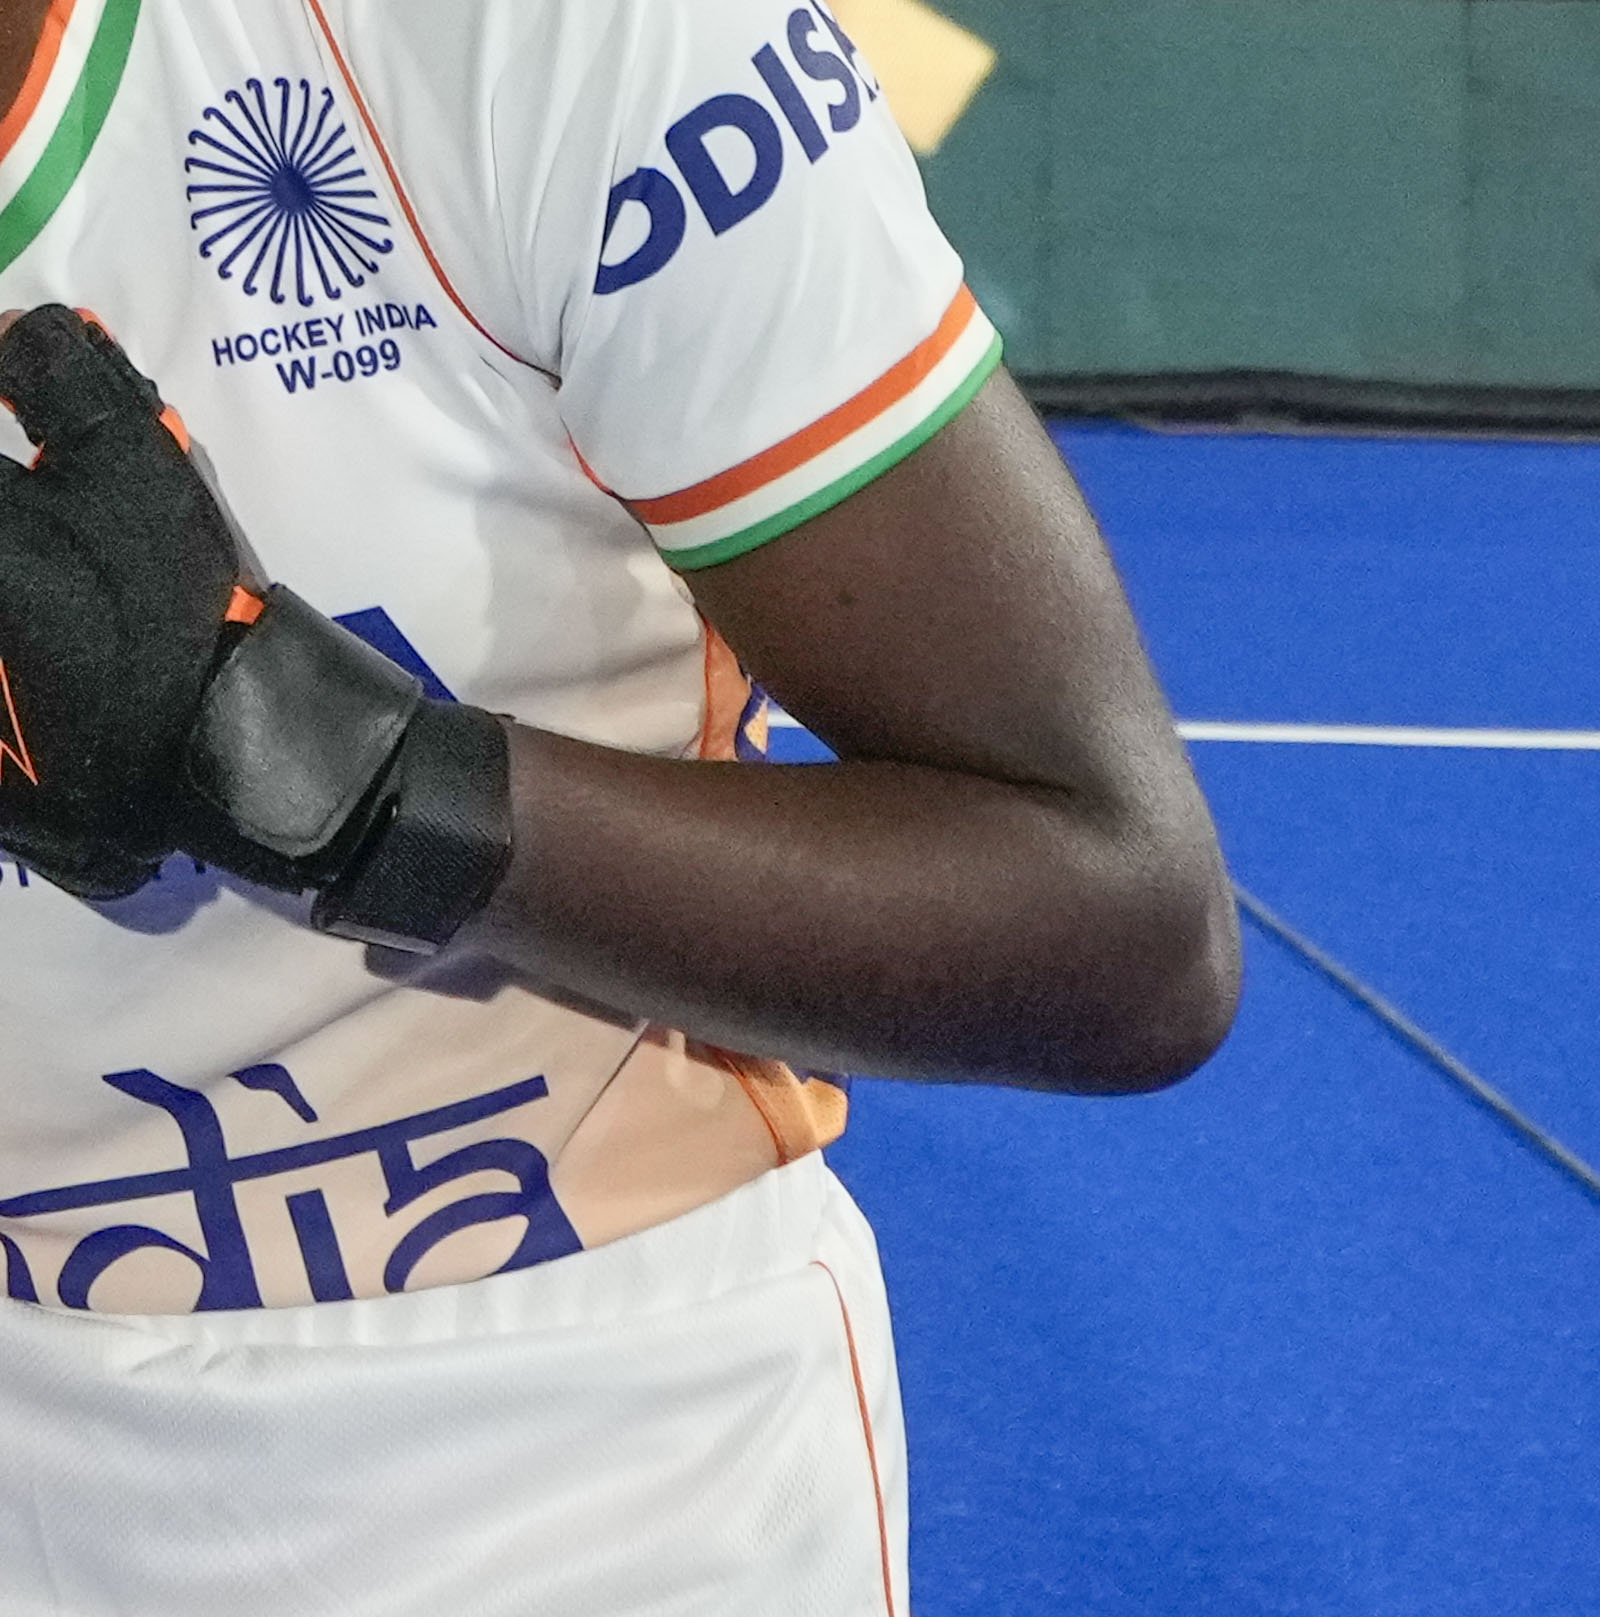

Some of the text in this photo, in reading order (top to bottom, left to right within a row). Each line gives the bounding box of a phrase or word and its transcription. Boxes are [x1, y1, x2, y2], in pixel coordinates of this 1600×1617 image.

[211, 302, 438, 367] HOCKEY INDIA
[275, 338, 402, 394] W-099
